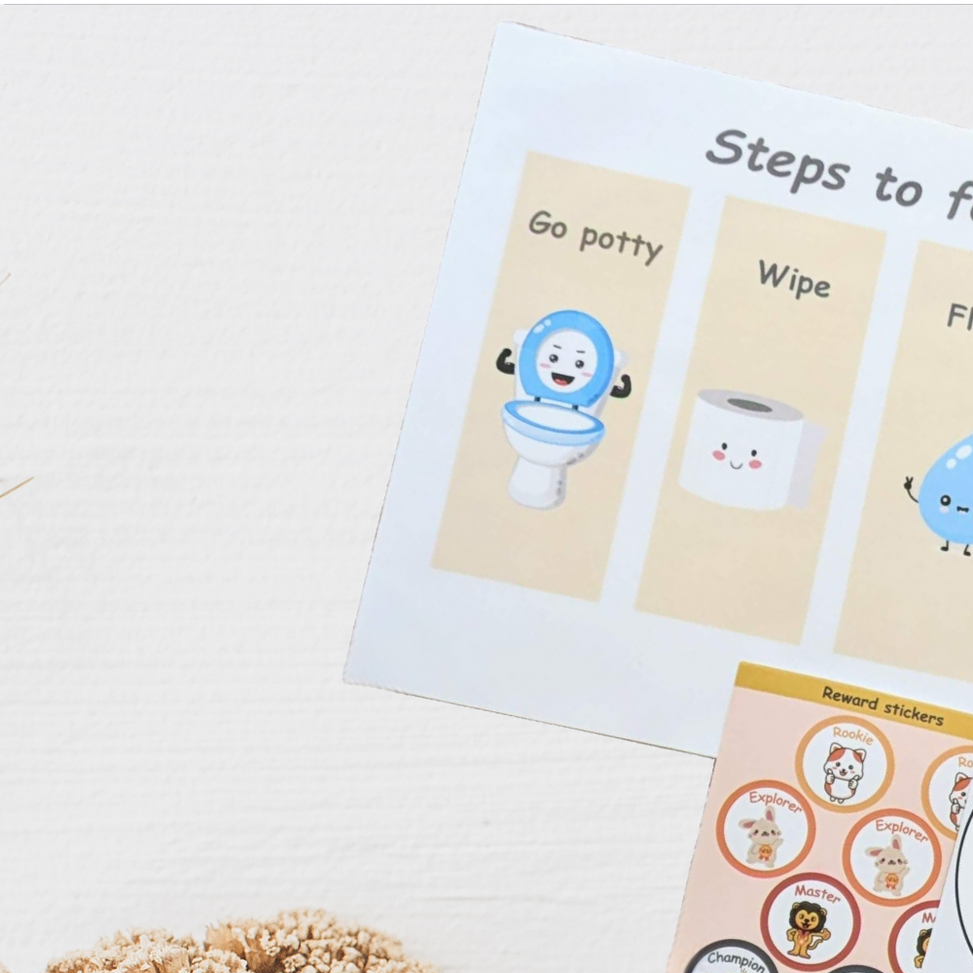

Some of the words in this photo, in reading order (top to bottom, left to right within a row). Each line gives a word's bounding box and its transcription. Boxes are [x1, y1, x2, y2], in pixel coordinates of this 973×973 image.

[705, 129, 851, 194] Steps
[875, 167, 923, 207] to
[529, 211, 567, 239] Go
[580, 225, 663, 267] potty
[759, 259, 831, 299] Wipe
[822, 686, 878, 711] Reward
[884, 701, 944, 726] stickers
[832, 726, 873, 746] Rookie
[749, 790, 802, 814] Explorer
[875, 819, 929, 844] Explorer
[794, 885, 841, 904] Master
